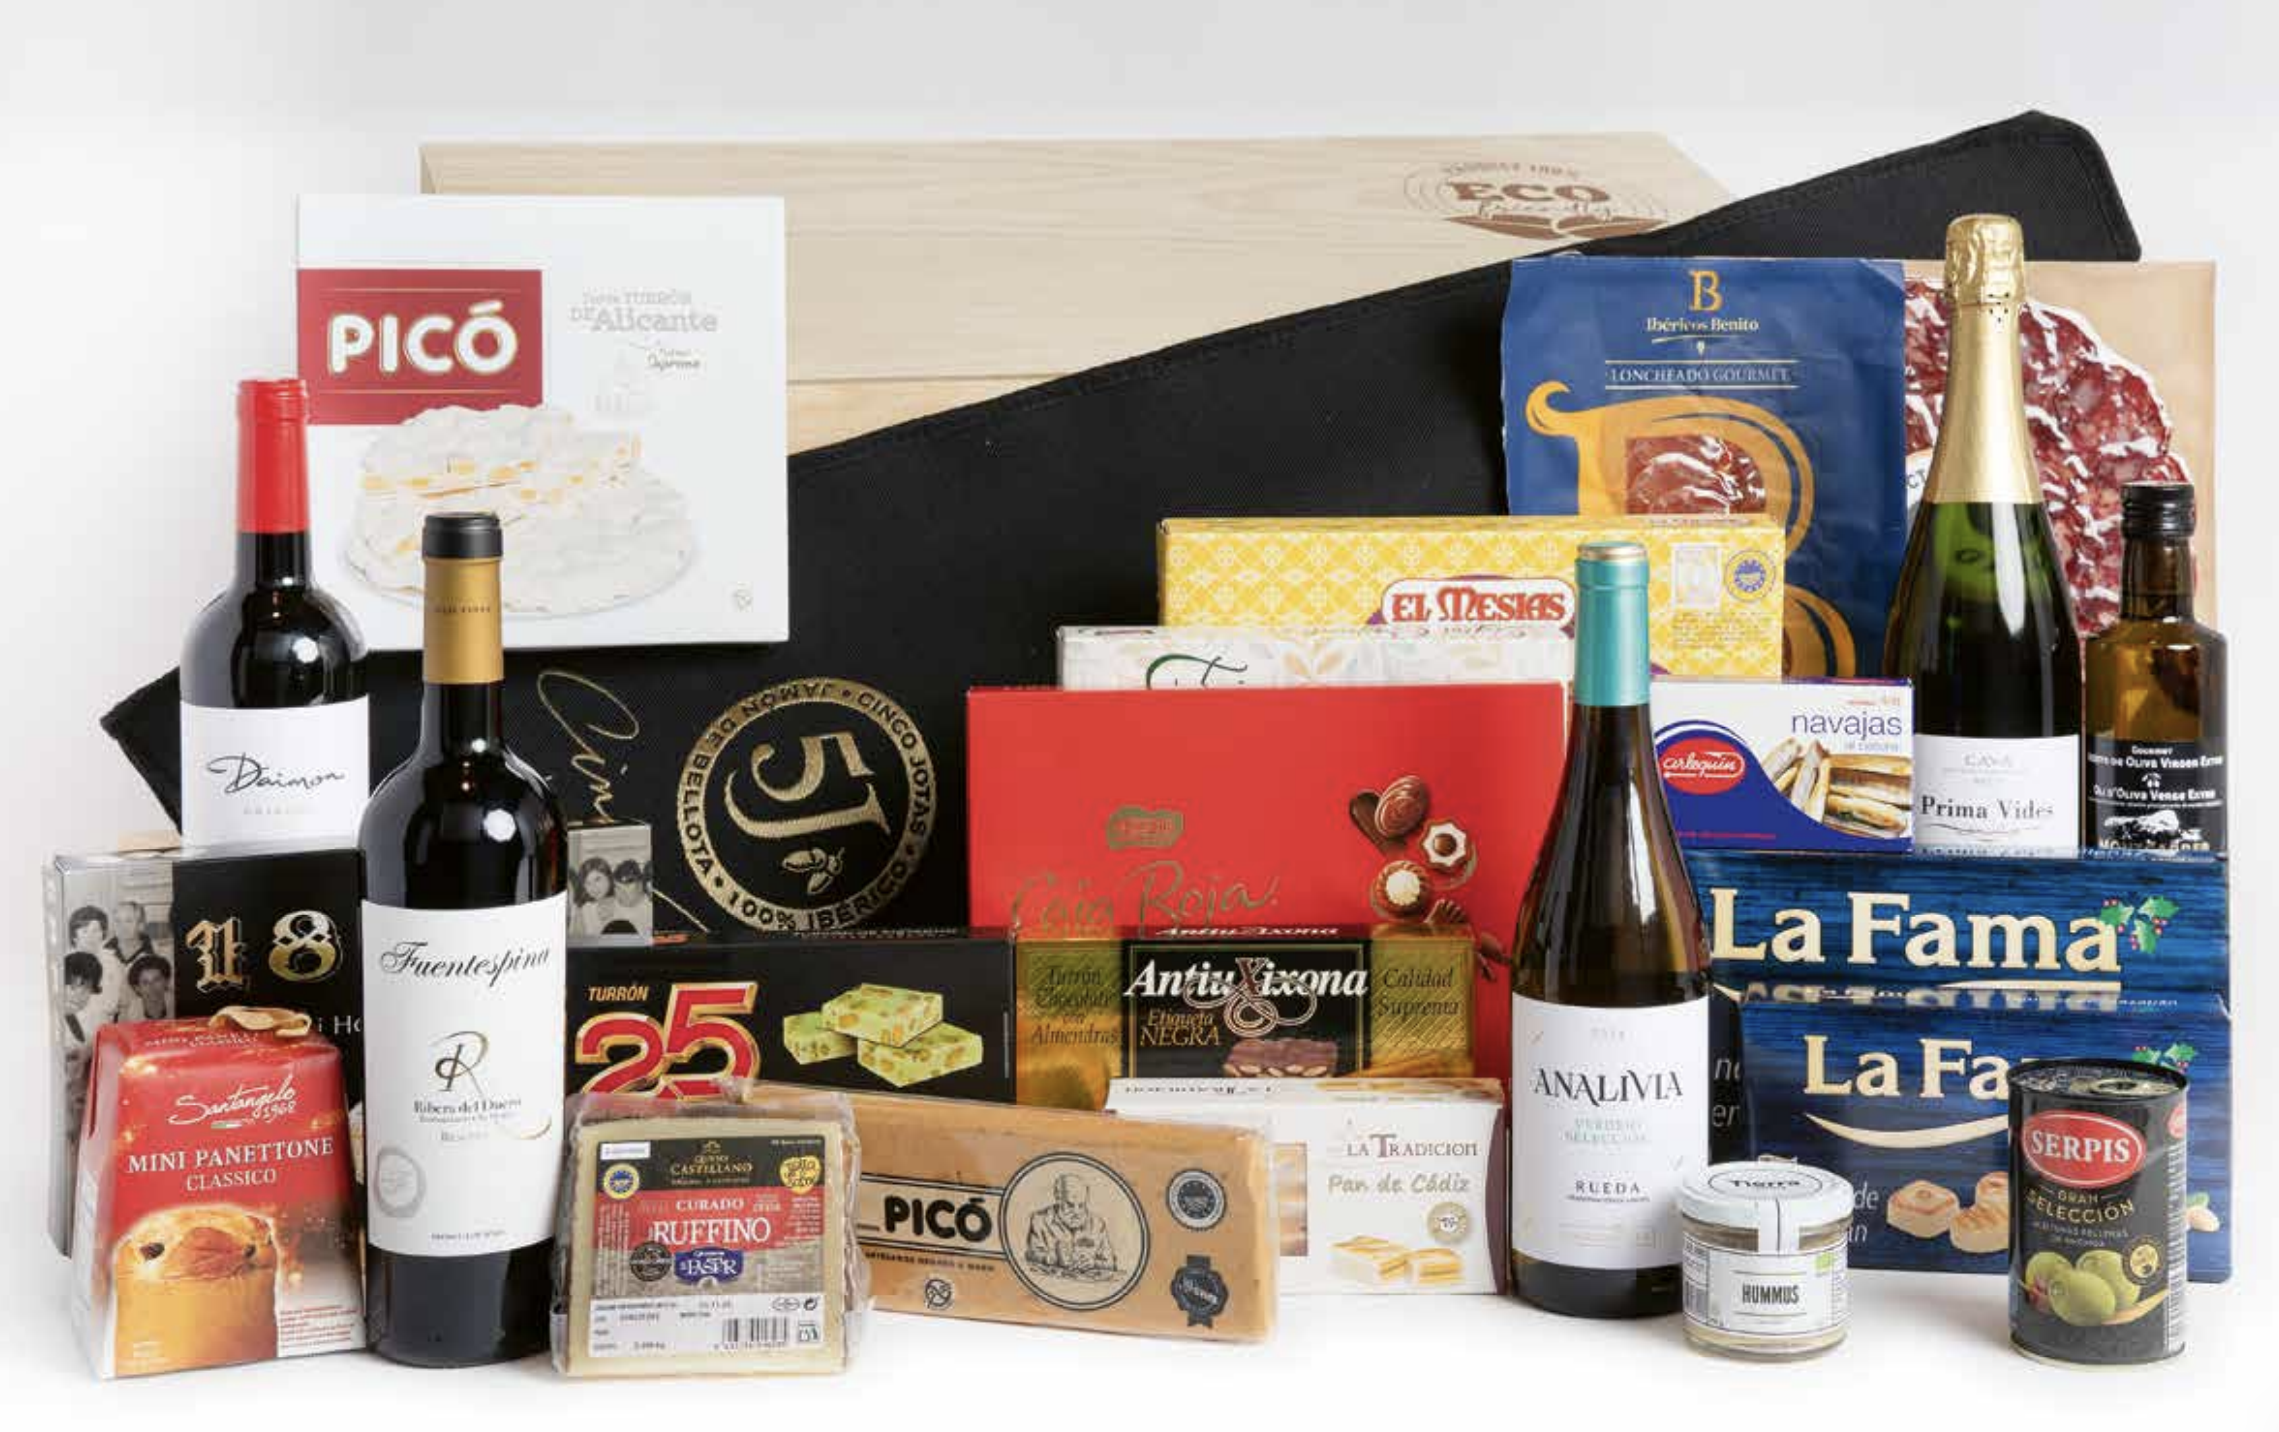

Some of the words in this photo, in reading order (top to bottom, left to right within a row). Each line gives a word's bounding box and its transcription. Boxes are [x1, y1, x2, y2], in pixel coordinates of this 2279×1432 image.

[1446, 181, 1611, 201] ECO
[1688, 269, 1723, 312] B
[590, 306, 718, 333] Alicante
[1646, 316, 1708, 332] Ibéricos
[1710, 316, 1760, 332] Benito
[327, 298, 518, 375] PICÓ
[1610, 367, 1710, 382] LONCHEADO
[1712, 367, 1790, 381] GOURMET
[1391, 592, 1432, 623] EL
[1436, 586, 1566, 624] MESIAS
[705, 718, 738, 748] DE
[1791, 710, 1902, 740] navajas
[206, 752, 346, 794] Daimon
[856, 691, 917, 750] CINCO
[908, 757, 930, 837] JOTAS
[1662, 750, 1738, 780] arlequin
[2125, 756, 2158, 769] OLIVA
[2160, 757, 2199, 769] VIRGEN
[1921, 795, 1989, 819] Prima
[2000, 798, 2055, 819] Vides
[2187, 788, 2217, 800] EXTRA
[681, 753, 714, 877] BELLOTA
[728, 890, 797, 931] 100%
[1708, 888, 1826, 964] La
[1847, 891, 2122, 973] Fama
[379, 941, 551, 988] Fuentespina
[1383, 966, 1453, 988] Calidad
[588, 985, 649, 1002] TURRÓN
[1147, 1008, 1214, 1028] Etiqueta
[574, 982, 761, 1099] 25
[1031, 1022, 1119, 1046] Almendras
[1139, 1025, 1221, 1047] NEGRA
[1803, 1035, 1901, 1097] La
[1919, 1038, 2011, 1100] Fa
[167, 1073, 297, 1125] Santangelo
[1533, 1067, 1684, 1107] ANALIVIA
[126, 1150, 187, 1174] MINI
[195, 1136, 335, 1168] PANETTONE
[1346, 1142, 1369, 1157] LA
[2031, 1130, 2131, 1163] SERPIS
[185, 1167, 277, 1191] CLASSICO
[1328, 1174, 1369, 1195] Pan
[1376, 1173, 1402, 1194] de
[1410, 1172, 1471, 1195] Cádiz
[1575, 1180, 1641, 1194] RUEDA
[675, 1198, 745, 1212] CURADO
[884, 1194, 993, 1243] PICÓ
[2027, 1190, 2134, 1224] SELECCIÓN
[652, 1216, 772, 1246] RUFFINO
[1741, 1283, 1800, 1305] HUMMUS
